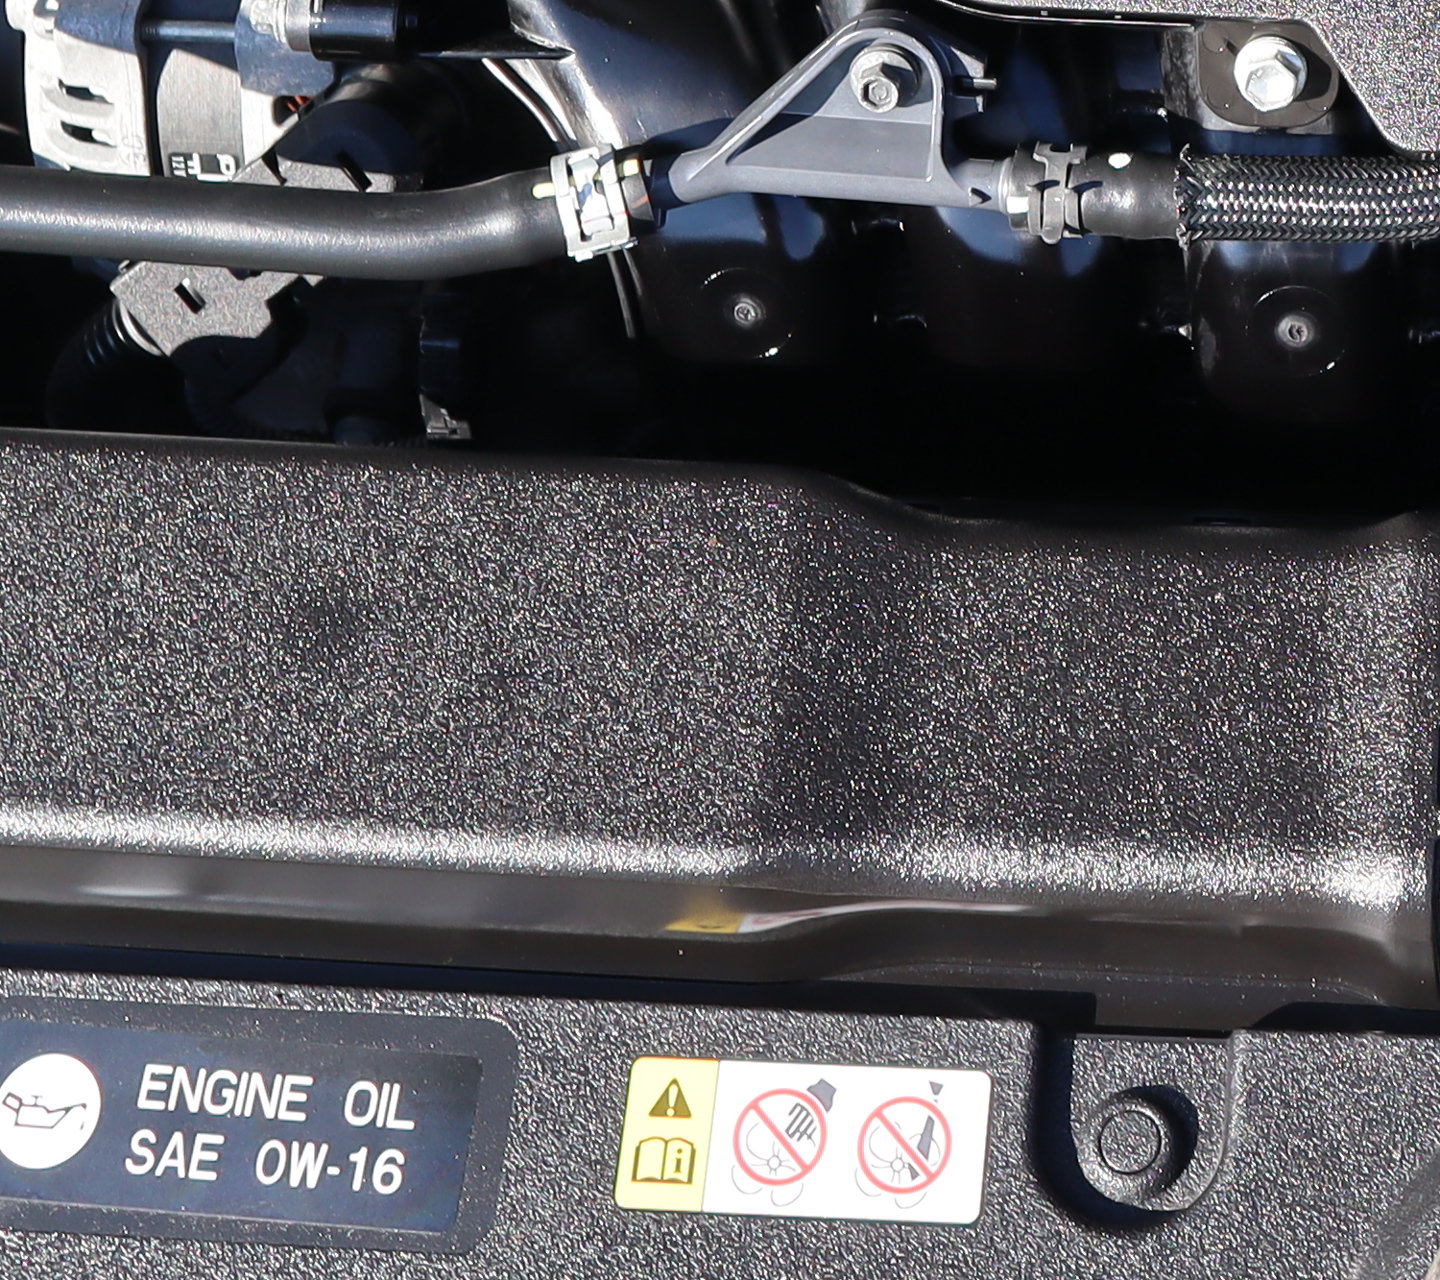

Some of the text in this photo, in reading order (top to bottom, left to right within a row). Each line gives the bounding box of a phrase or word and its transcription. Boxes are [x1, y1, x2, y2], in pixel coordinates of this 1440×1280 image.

[137, 1063, 417, 1132] ENGINE OIL
[123, 1131, 405, 1196] SAE 0W-16
